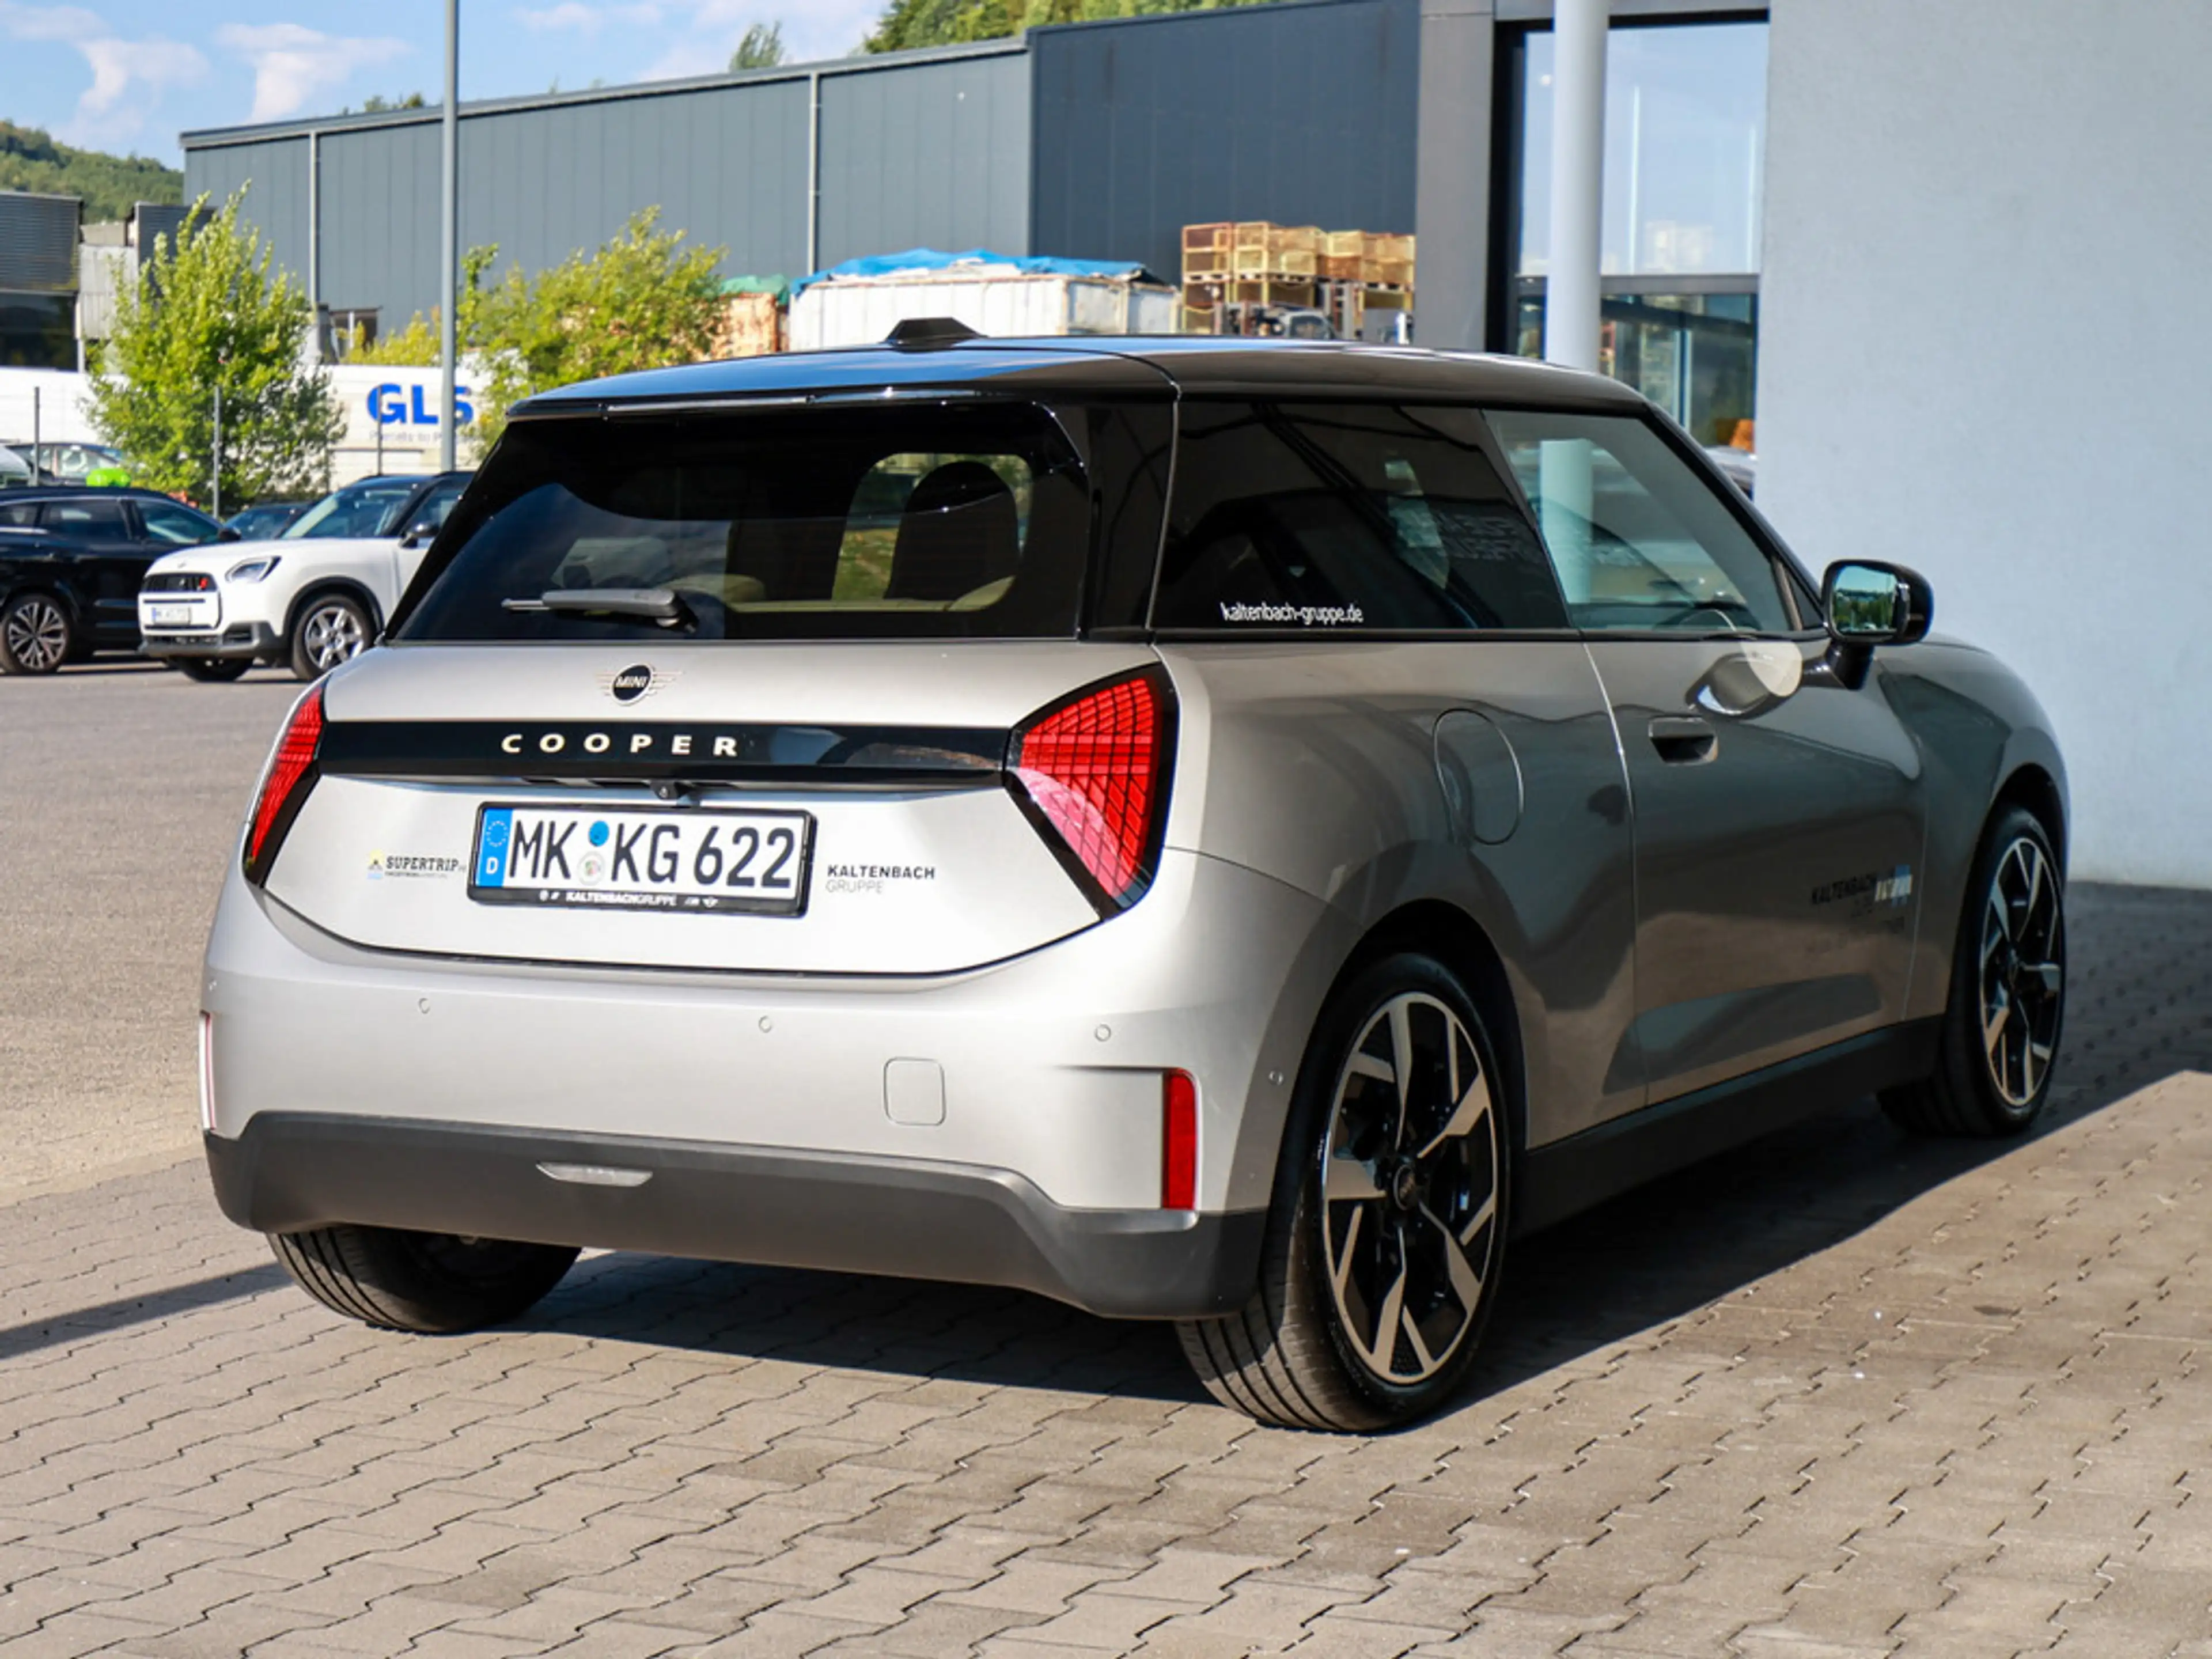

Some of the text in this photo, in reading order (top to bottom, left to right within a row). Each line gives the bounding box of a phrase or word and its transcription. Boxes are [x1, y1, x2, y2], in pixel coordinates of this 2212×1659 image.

[366, 382, 474, 426] GLS
[1220, 602, 1363, 625] kaltenbach-gruppe.de
[615, 676, 648, 688] MINI
[501, 733, 737, 756] COOPER
[509, 820, 796, 888] MK KG 622
[386, 855, 459, 872] SUPERTRIP
[485, 856, 499, 874] D
[827, 864, 935, 880] KALTENBACH
[825, 879, 883, 894] GRUPPE
